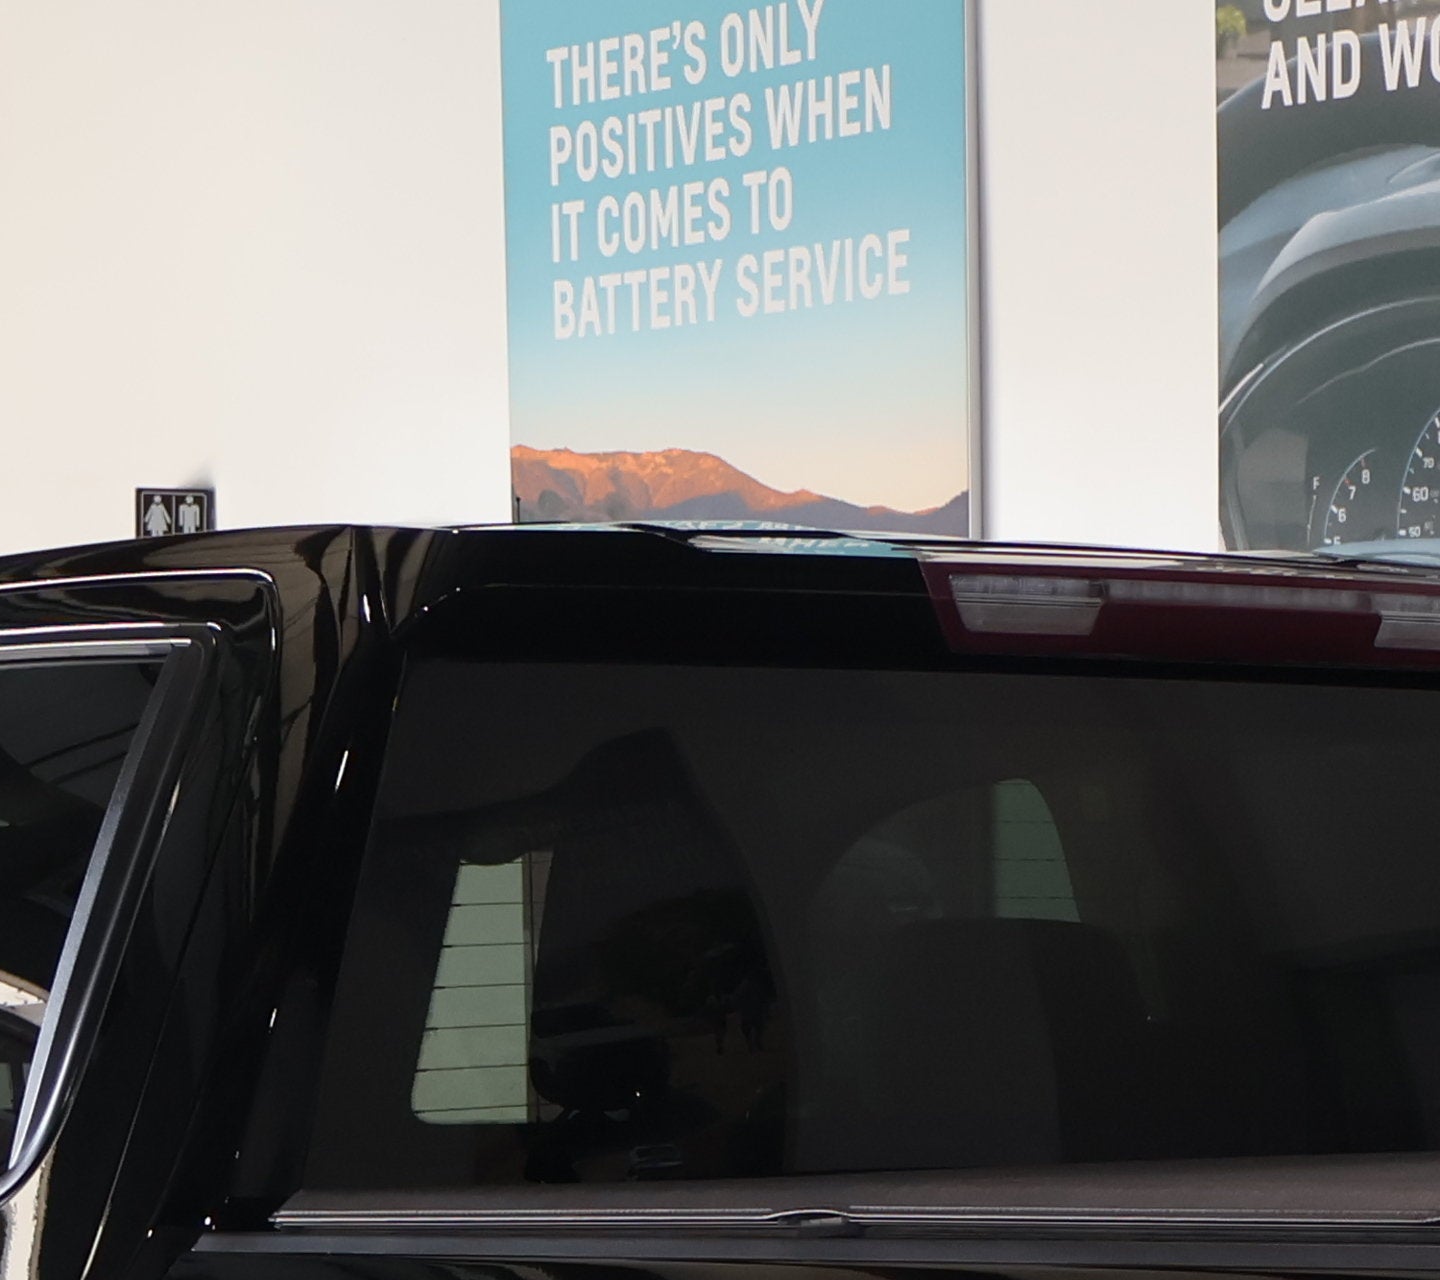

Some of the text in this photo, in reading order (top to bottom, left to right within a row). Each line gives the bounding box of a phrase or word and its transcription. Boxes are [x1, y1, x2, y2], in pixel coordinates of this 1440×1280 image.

[720, 0, 824, 77] ONLY
[1261, 28, 1360, 109] AND
[550, 64, 891, 186] POSITIVES WHEN
[552, 166, 793, 263] IT COMES TO
[554, 228, 910, 340] BATTERY SERVICE
[1338, 507, 1347, 523] 6
[1348, 486, 1356, 500] 7
[1361, 469, 1371, 484] 8
[1412, 487, 1429, 502] 60
